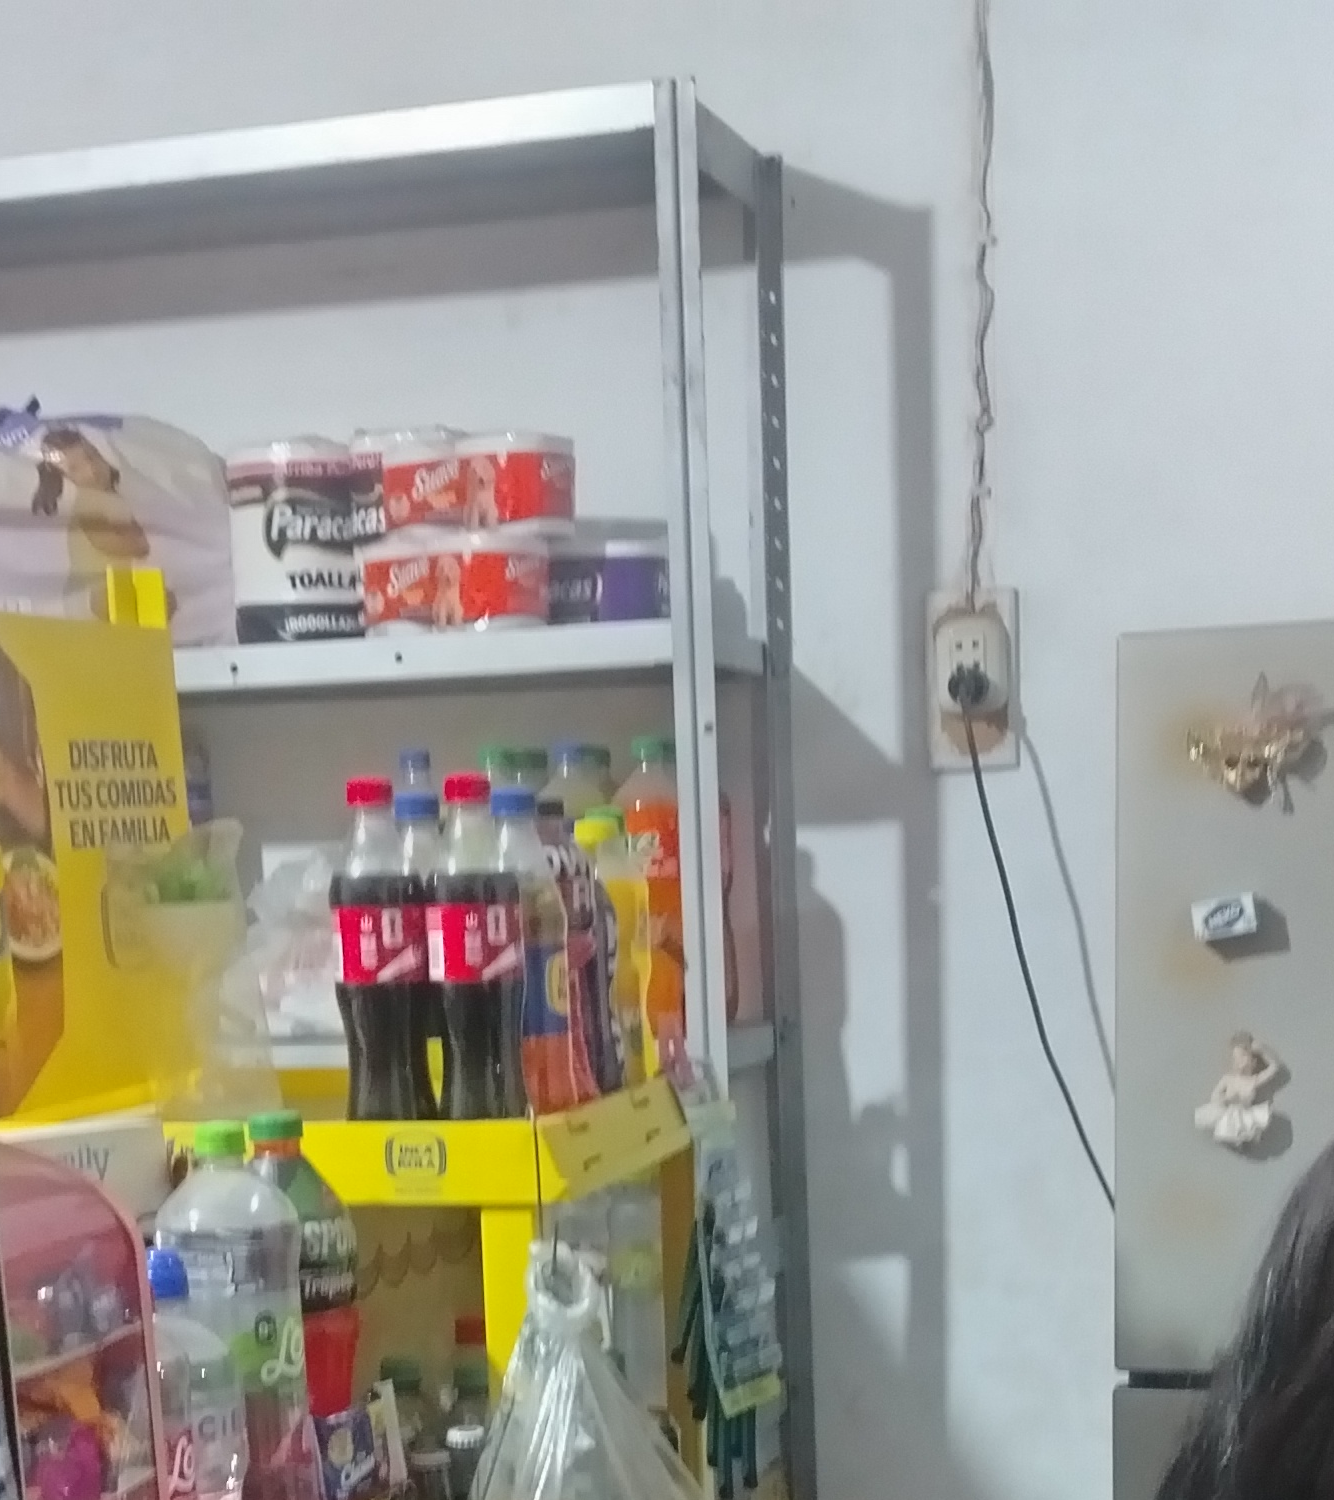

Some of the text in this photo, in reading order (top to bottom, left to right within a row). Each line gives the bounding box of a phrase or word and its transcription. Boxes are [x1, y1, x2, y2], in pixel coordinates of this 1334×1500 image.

[68, 740, 160, 771] DISFRUTA
[55, 776, 178, 811] TUS COMIDAS
[69, 815, 172, 849] EN FAMILIA
